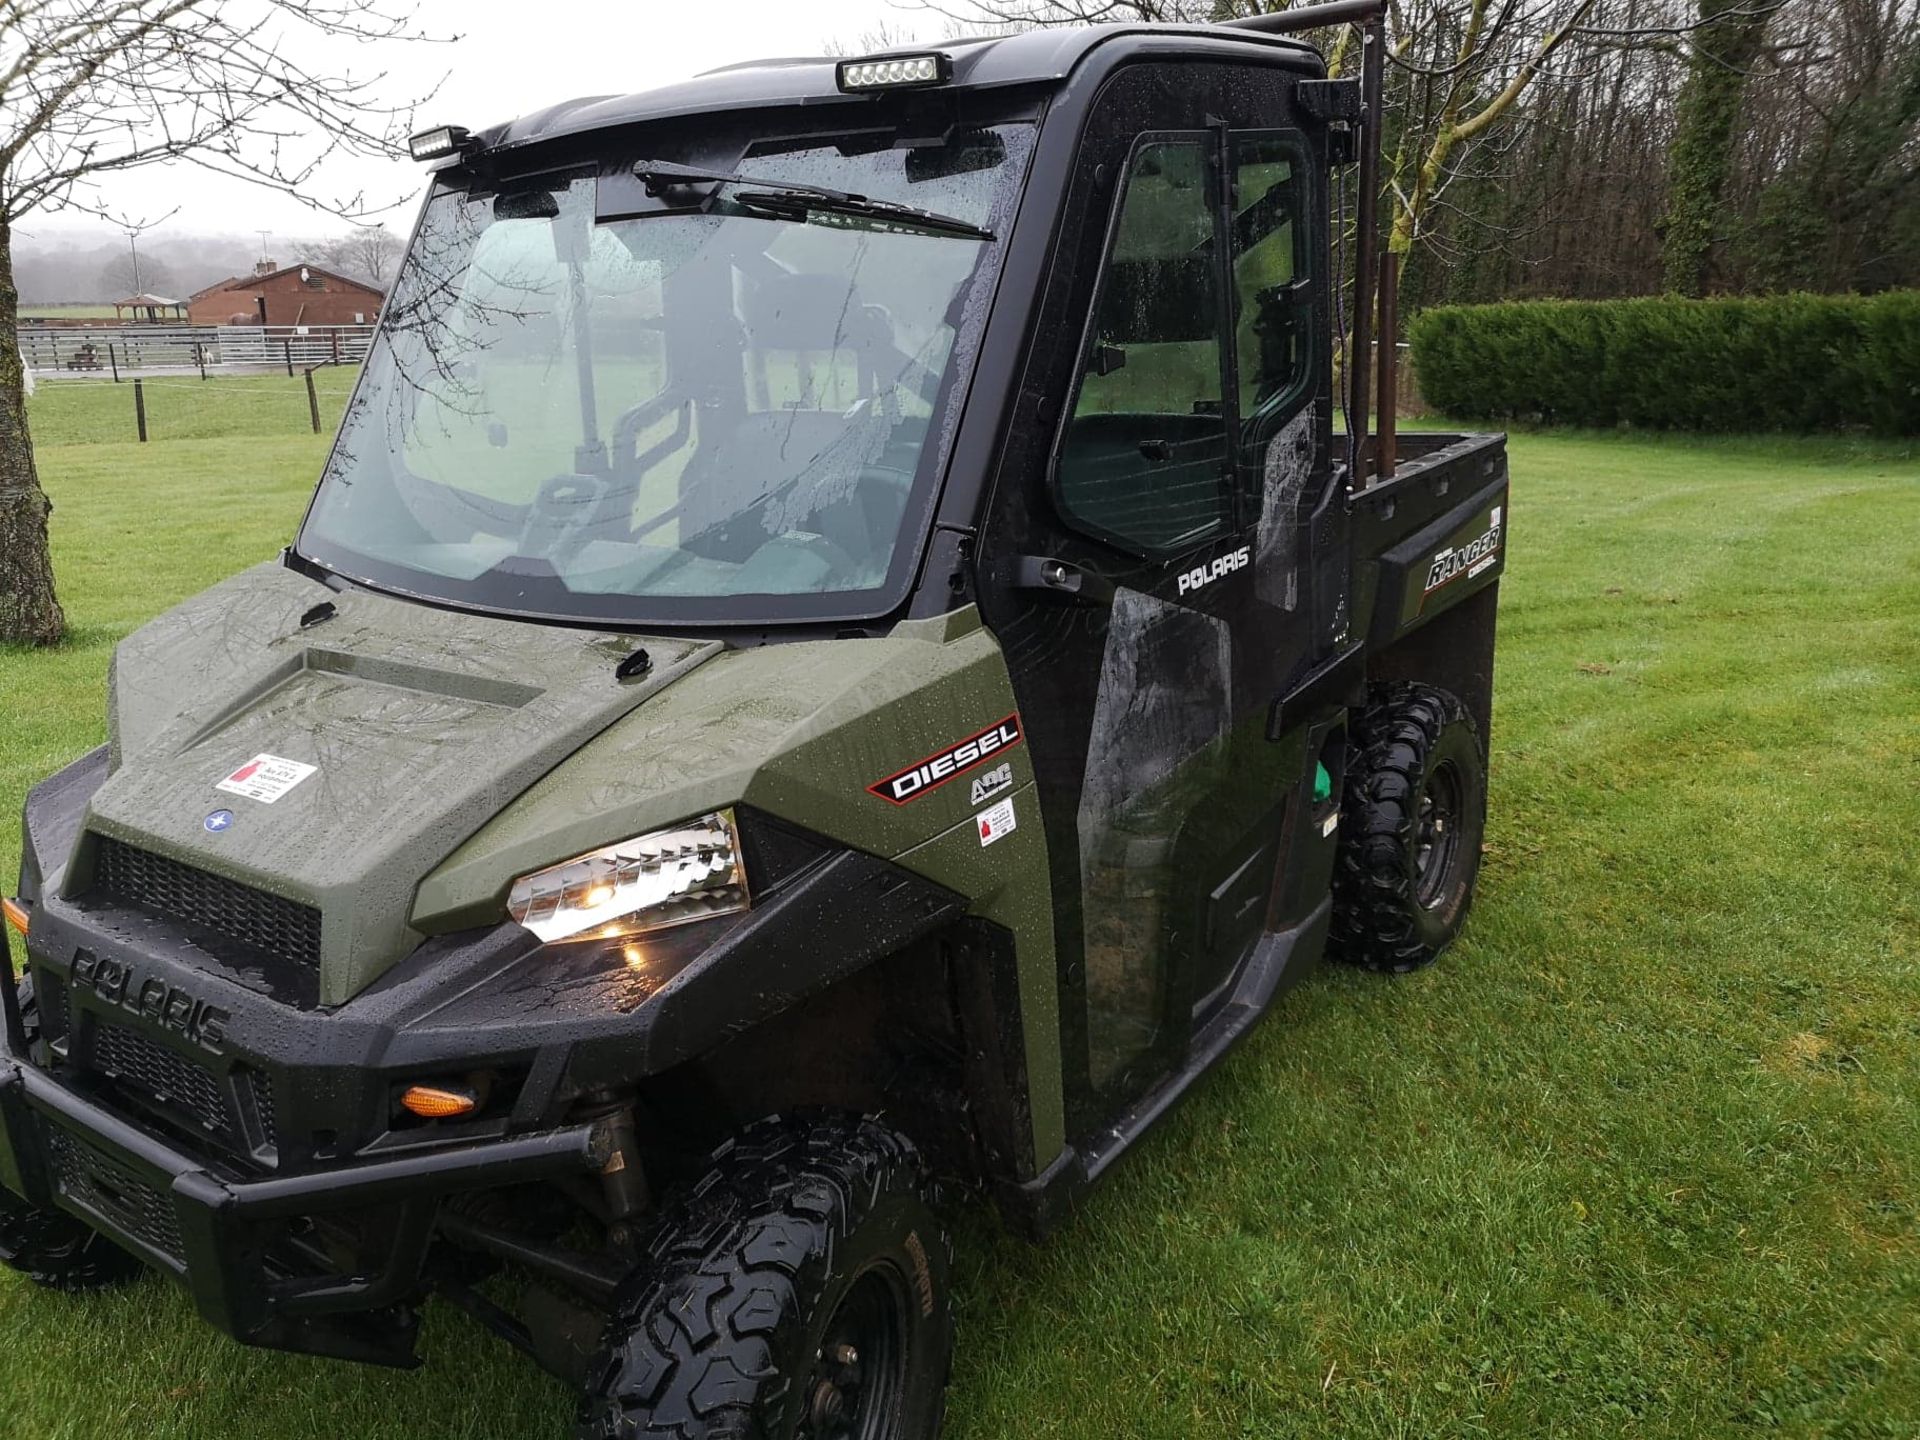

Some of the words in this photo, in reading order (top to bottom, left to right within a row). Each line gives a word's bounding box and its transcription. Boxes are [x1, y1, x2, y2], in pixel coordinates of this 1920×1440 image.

[1178, 545, 1249, 596] POLARIS
[1425, 526, 1500, 591] RANGER
[892, 725, 1018, 799] DIESEL
[70, 946, 232, 1055] POLARIS
